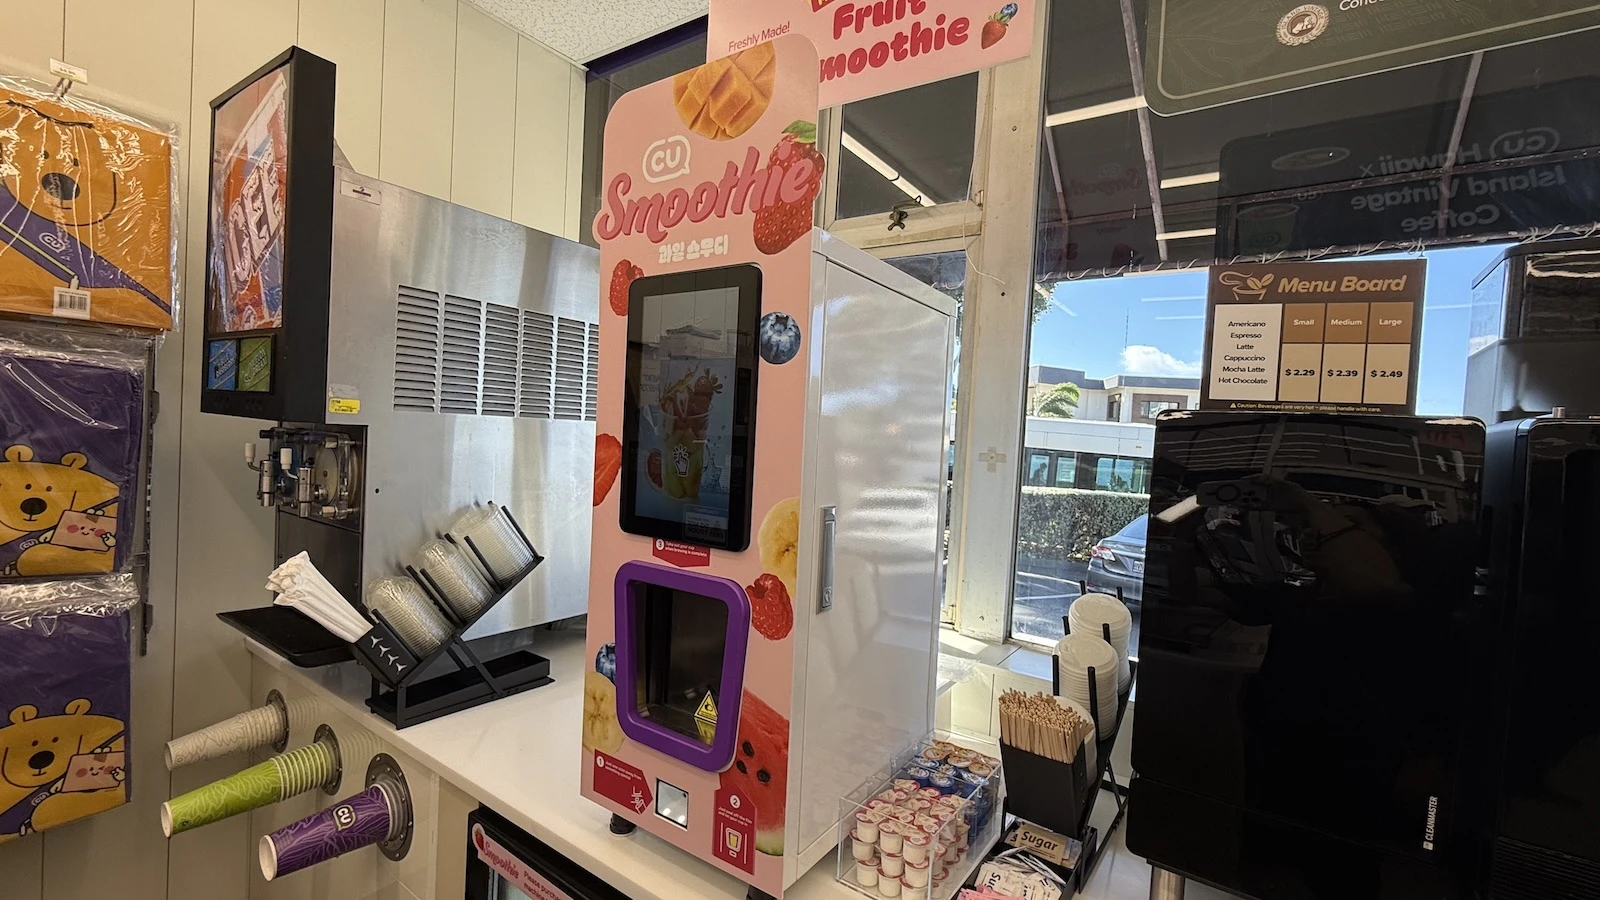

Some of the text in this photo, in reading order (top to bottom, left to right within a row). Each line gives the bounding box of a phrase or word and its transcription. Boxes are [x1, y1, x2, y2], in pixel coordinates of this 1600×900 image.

[832, 0, 927, 39] Fruit
[1304, 6, 1324, 20] VINTAGE
[728, 22, 791, 52] Freshly Made!
[820, 14, 970, 83] moothie
[651, 146, 681, 172] CU
[597, 140, 814, 244] Smoothie
[44, 236, 61, 248] CU
[659, 235, 729, 264] 과일 스무디
[1277, 275, 1407, 294] Menu Board
[1293, 318, 1314, 326] Small
[1379, 318, 1402, 327] Large
[1232, 377, 1268, 385] Chocolate
[1285, 369, 1315, 377] $ 2.29
[1327, 369, 1333, 377] $
[1370, 370, 1403, 378] $ 2.49
[35, 794, 46, 803] CU
[337, 808, 351, 823] CU
[1424, 796, 1438, 841] CLEANMASTER
[1020, 830, 1059, 853] Sugar
[482, 841, 519, 879] Smoothie
[524, 871, 561, 900] Please purcha
